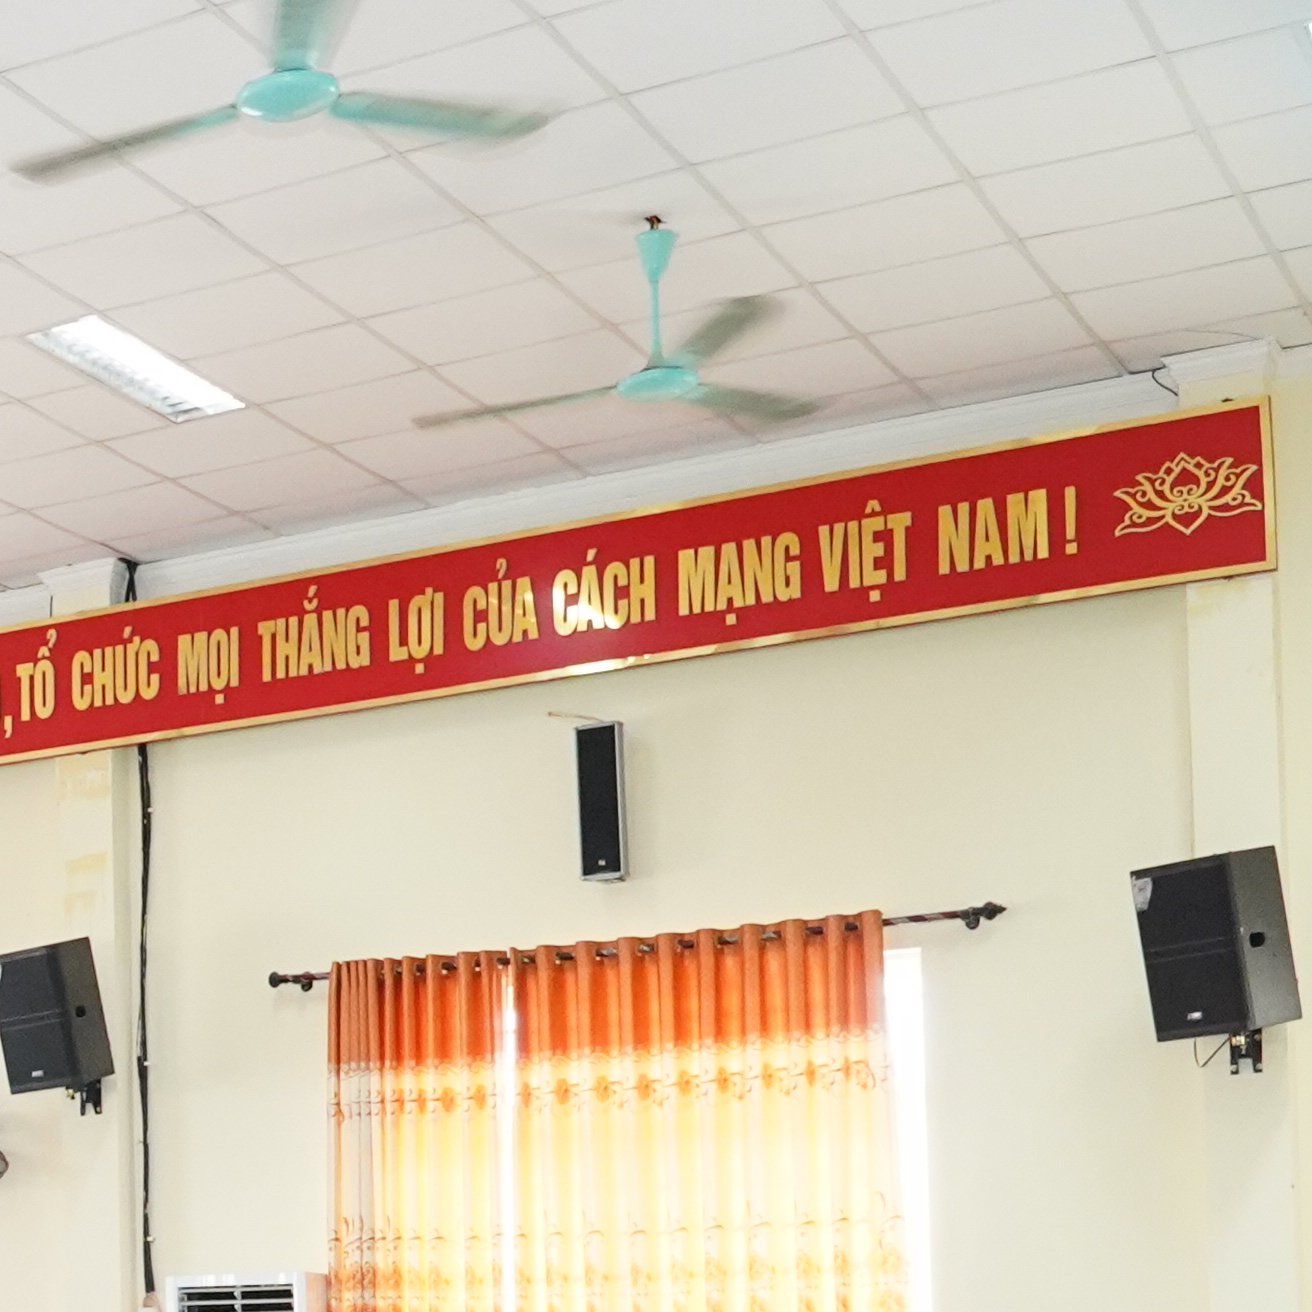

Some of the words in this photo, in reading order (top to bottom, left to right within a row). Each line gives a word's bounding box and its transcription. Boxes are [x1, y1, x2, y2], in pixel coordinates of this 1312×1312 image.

[15, 628, 57, 722] TỔ
[71, 626, 160, 711] CHỨC
[177, 626, 240, 705] MỌI
[257, 585, 371, 683] THẮNG
[388, 587, 444, 674] LỢI
[462, 558, 540, 652] CỦA
[549, 548, 656, 637] CÁCH
[677, 522, 802, 626] MẠNG
[818, 499, 912, 603] VIỆT
[938, 488, 1050, 576] NAM
